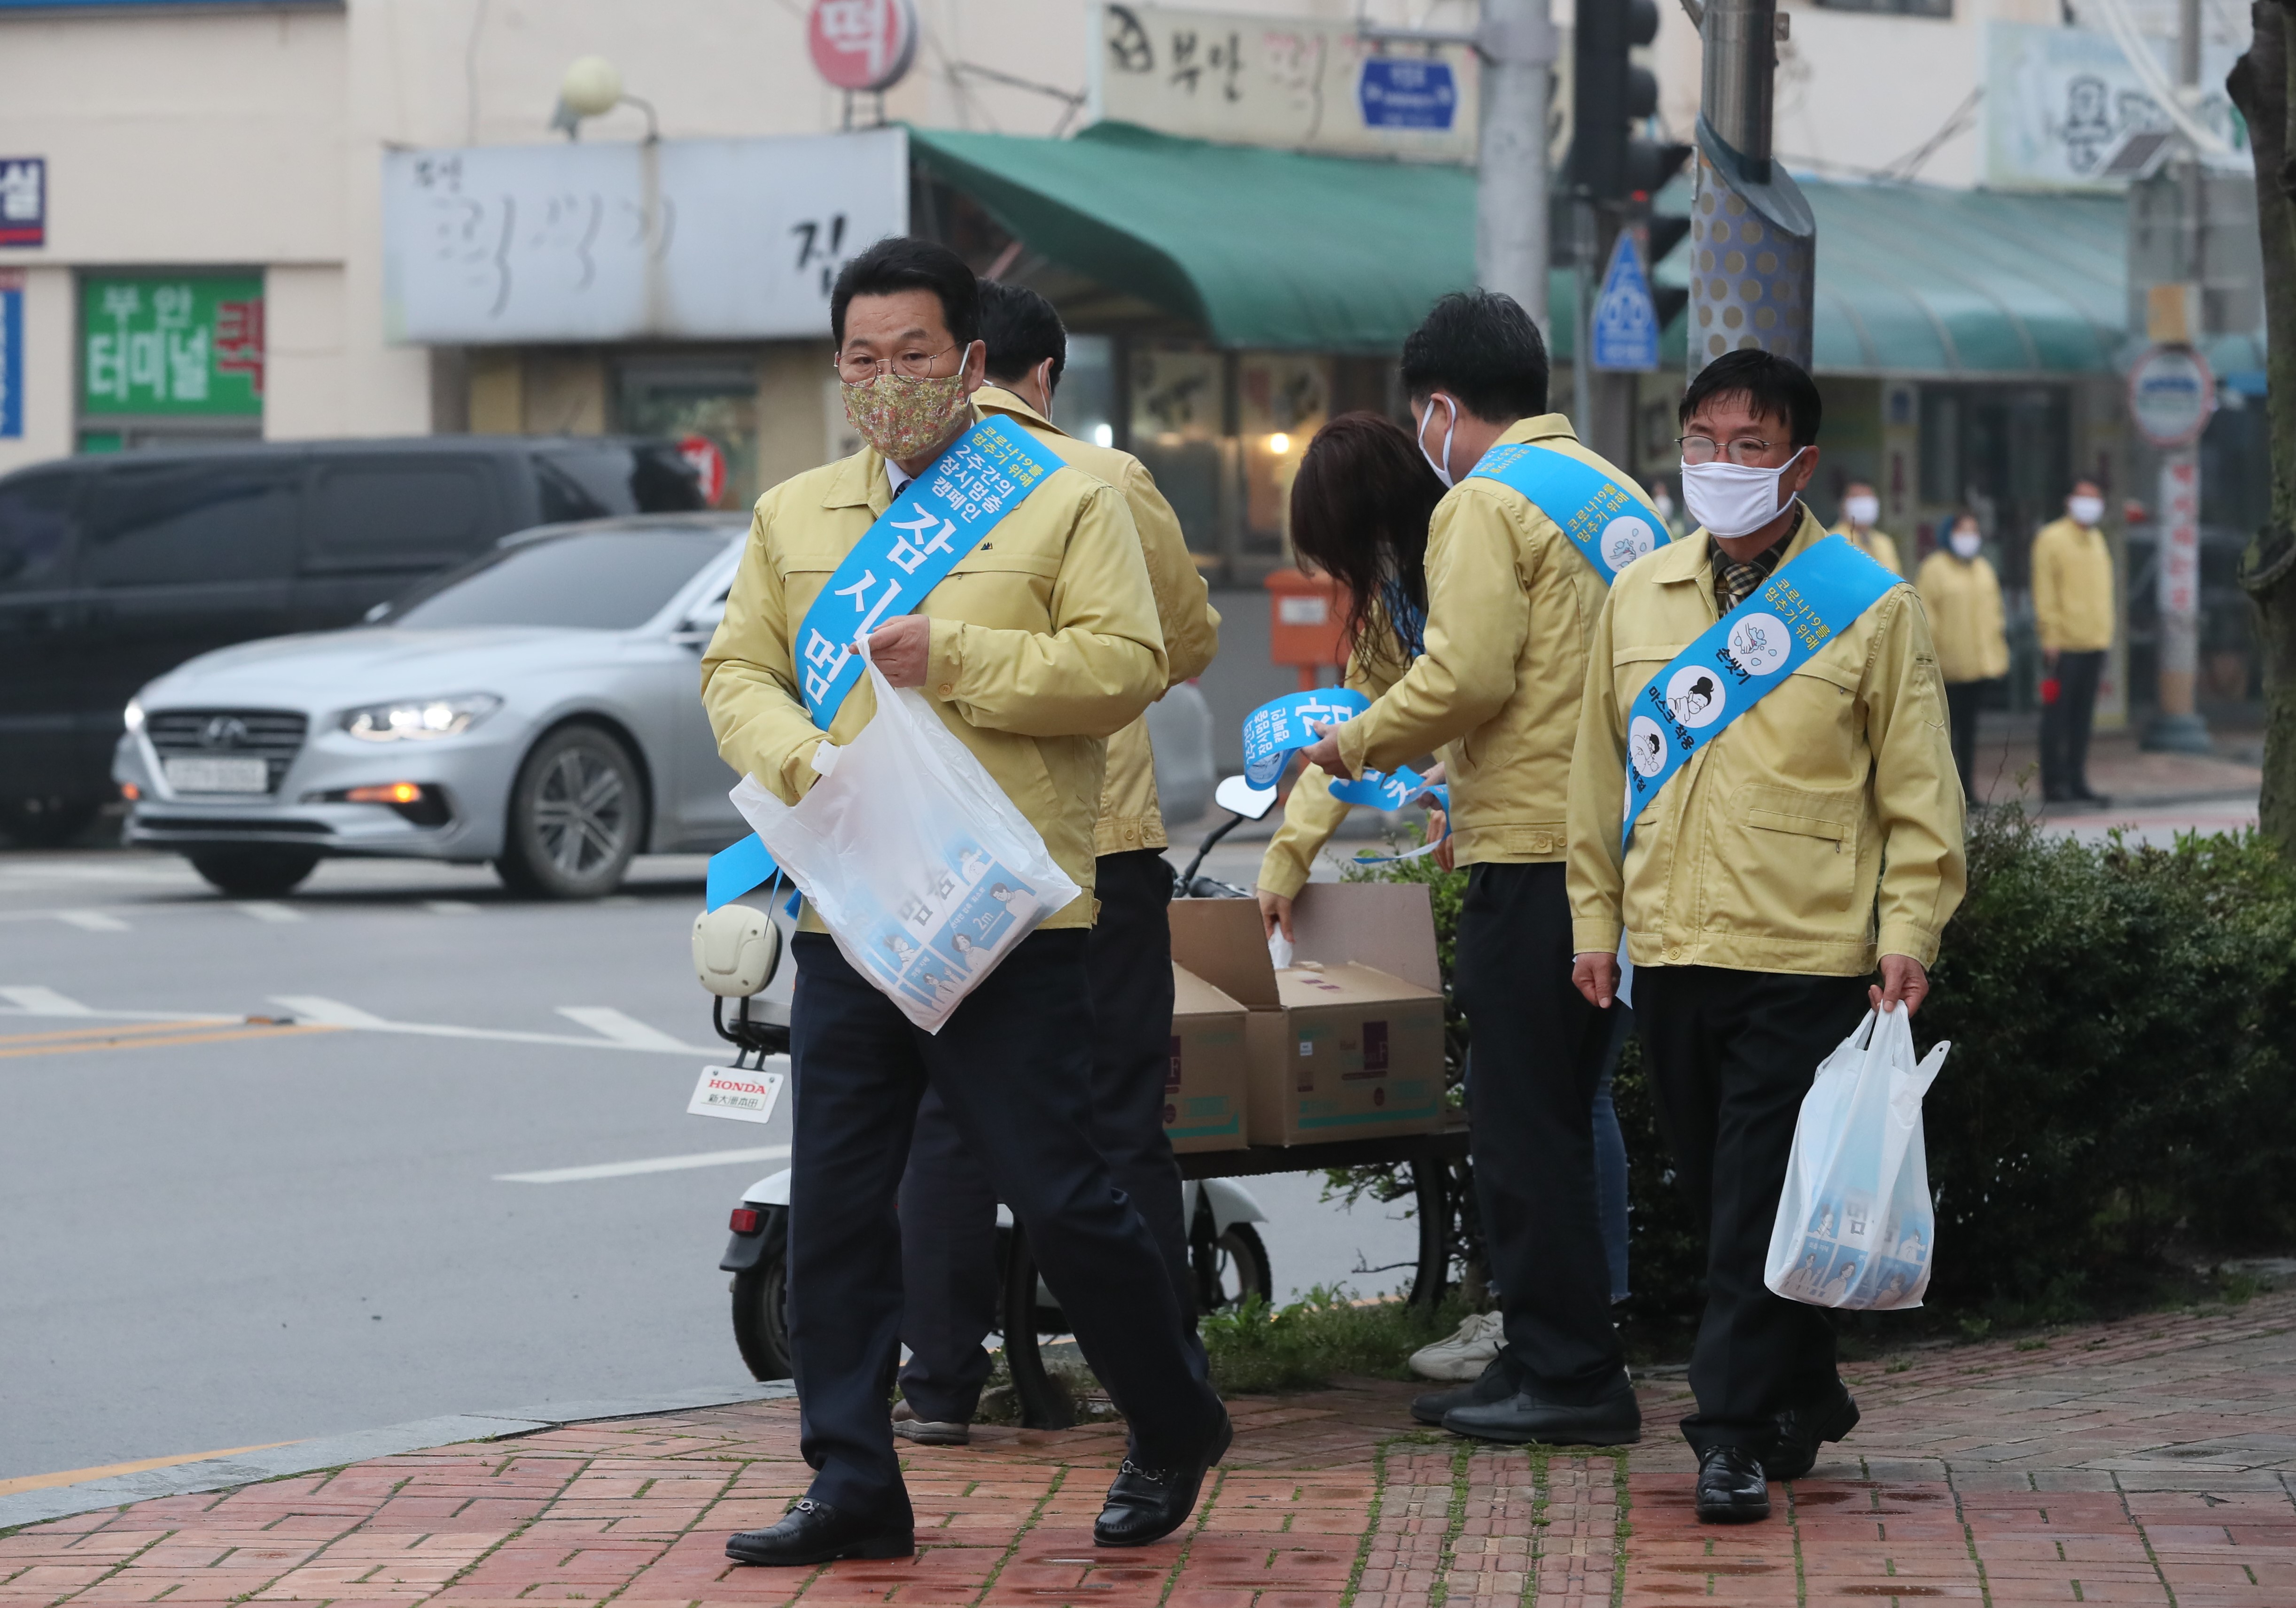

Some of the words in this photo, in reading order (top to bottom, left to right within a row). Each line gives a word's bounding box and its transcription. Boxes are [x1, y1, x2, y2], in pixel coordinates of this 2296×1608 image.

[1169, 29, 1243, 103] 부안
[102, 285, 194, 330] 부안
[88, 324, 210, 401] 터미널
[955, 444, 1016, 498] 2주간의
[972, 433, 1009, 465] 멈추기
[1008, 464, 1035, 488] 위해
[982, 426, 1044, 478] 코로나19를
[932, 476, 982, 523] 캠페인
[940, 455, 1003, 514] 잠시멈춤
[1567, 483, 1618, 532] 코로나19를
[1576, 510, 1610, 543] 멈추기
[1606, 491, 1630, 513] 위해
[1765, 587, 1798, 625] 멈추기
[1796, 623, 1820, 651] 위해
[1775, 578, 1830, 639] 코로나19를
[1715, 647, 1751, 685] 손씻기
[1253, 709, 1273, 756] 잠시멈춤
[1270, 707, 1290, 744] 캠페인
[1648, 685, 1676, 724] 마스크
[1674, 723, 1695, 751] 착용
[972, 912, 994, 930] 2m
[708, 1079, 766, 1095] HONDA
